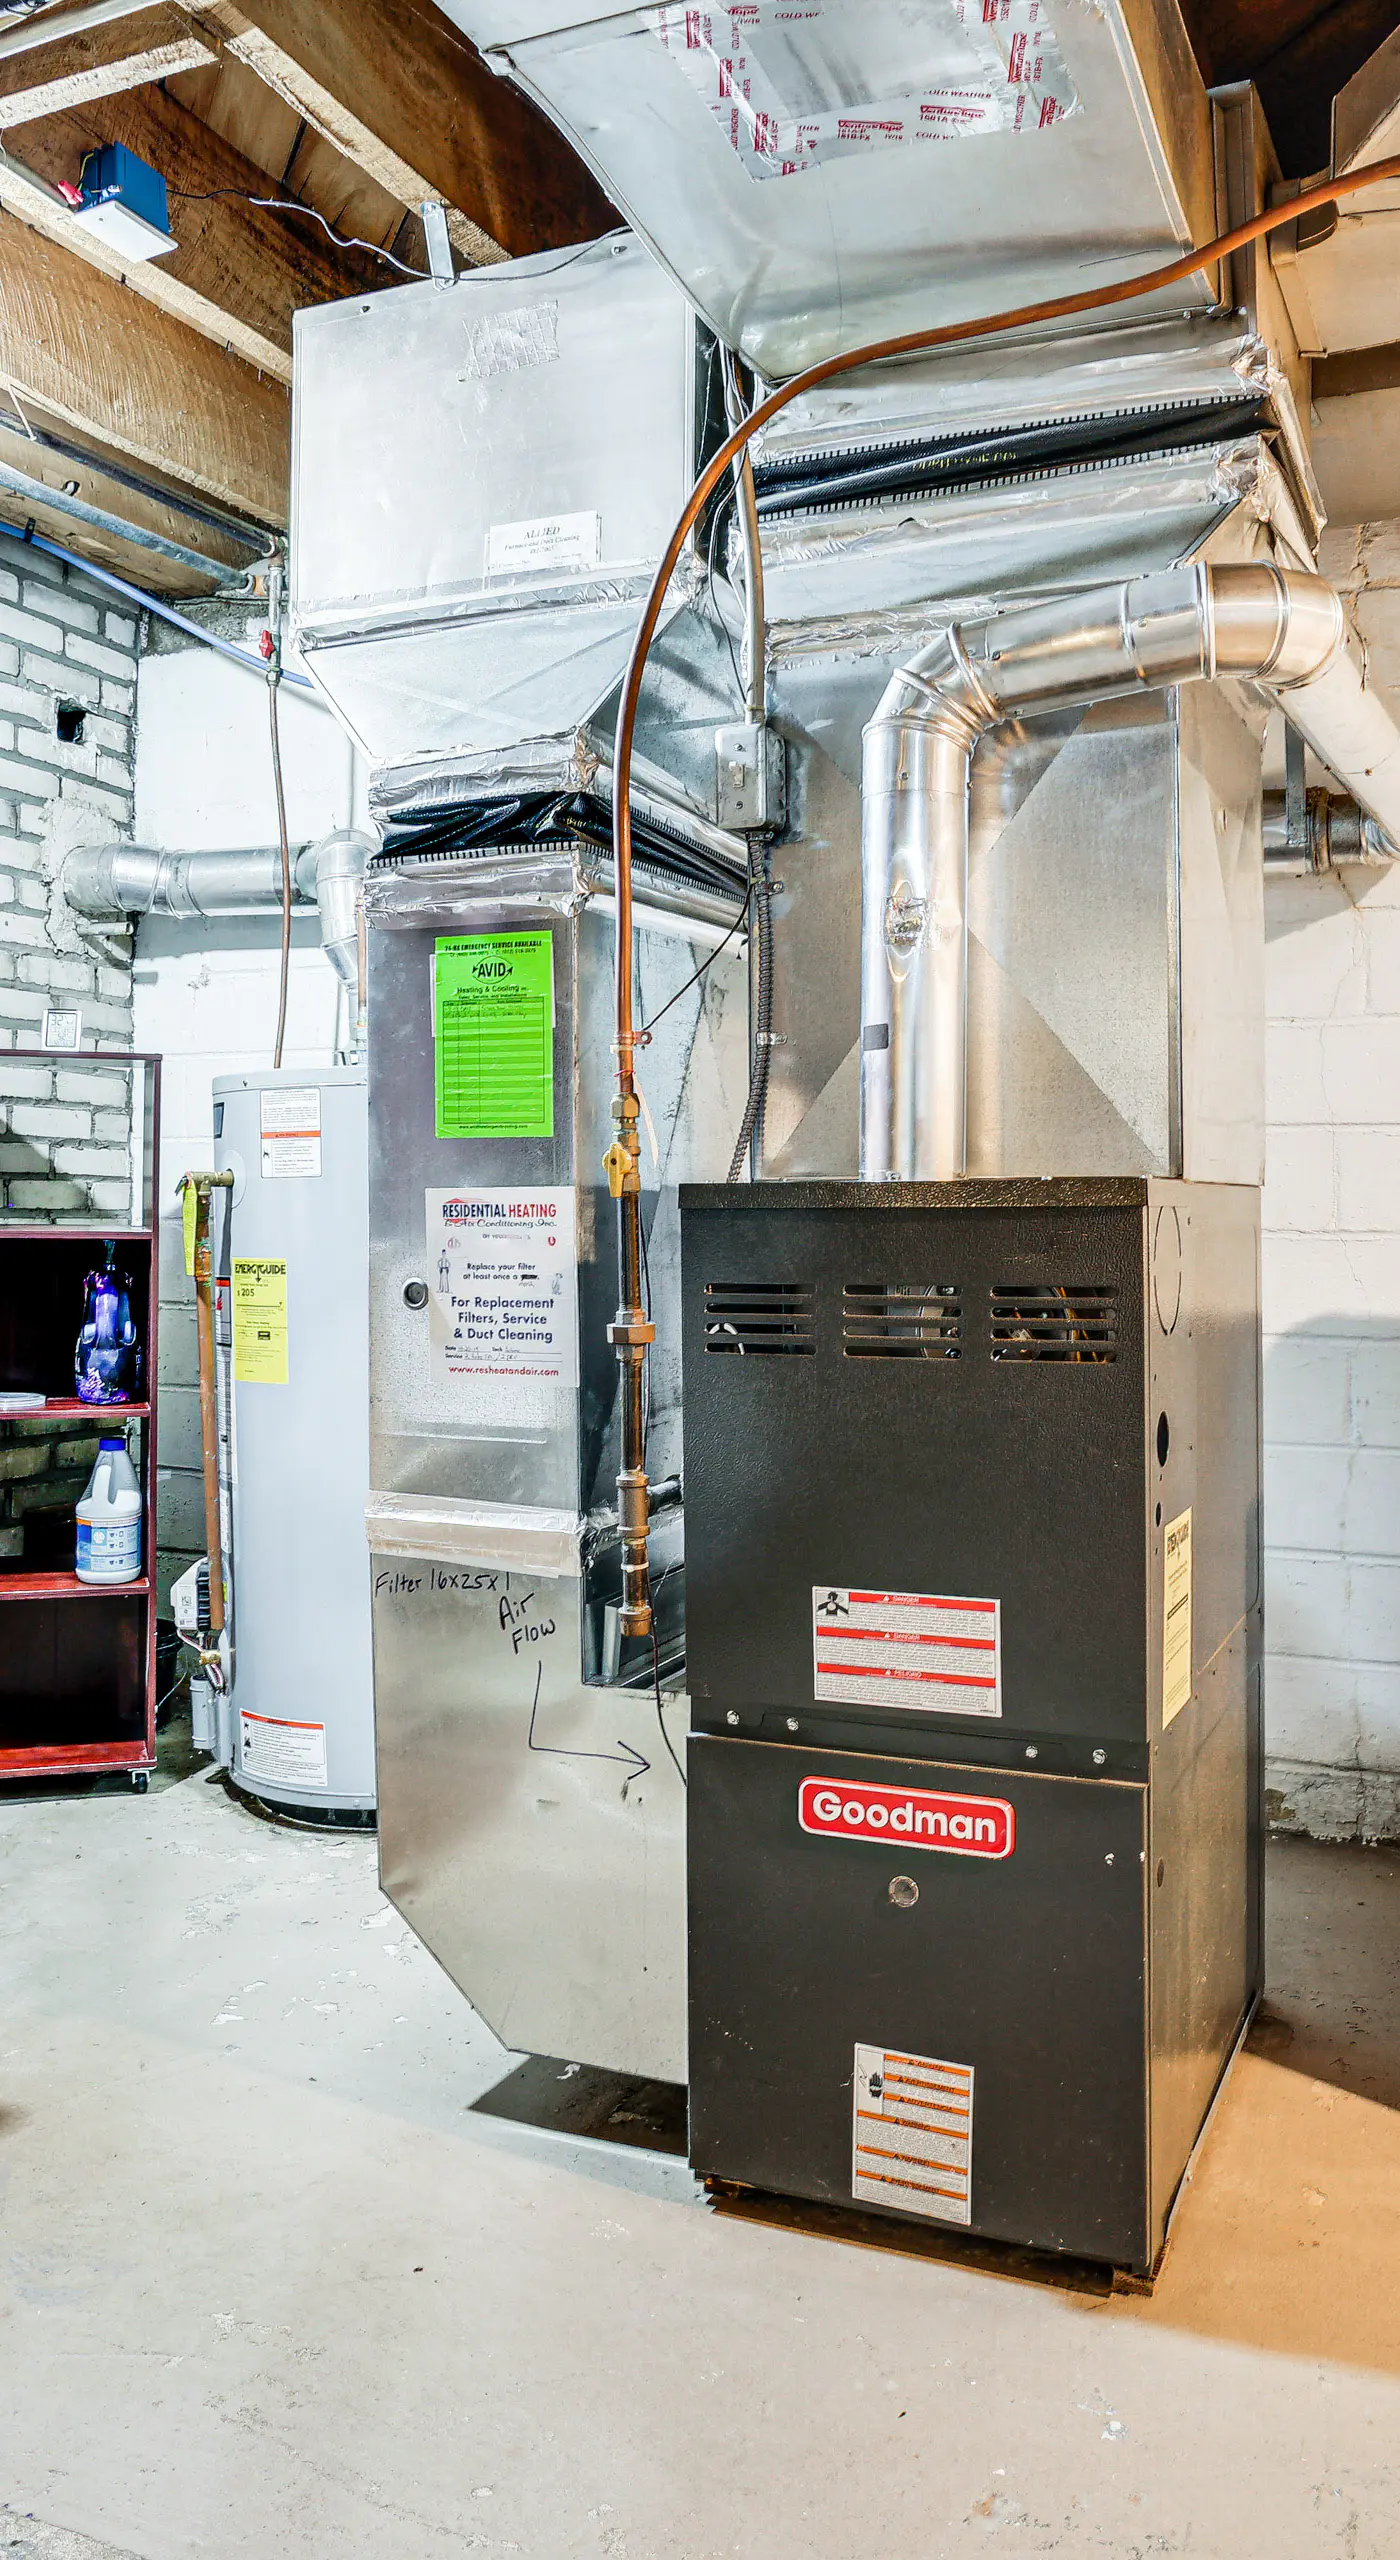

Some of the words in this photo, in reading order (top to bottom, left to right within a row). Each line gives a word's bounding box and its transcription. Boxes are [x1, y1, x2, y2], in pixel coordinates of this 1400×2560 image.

[477, 962, 507, 978] AVID
[491, 985, 520, 993] Cooling
[442, 1203, 506, 1218] RESIDENTIAL
[508, 1203, 557, 1218] HEATING
[477, 1219, 533, 1228] Conditioning
[467, 1263, 495, 1271] Replace
[498, 1264, 515, 1272] your
[518, 1262, 536, 1270] filter
[451, 1296, 470, 1307] For
[475, 1296, 555, 1311] Replacement
[458, 1311, 499, 1325] Filters,
[502, 1312, 548, 1325] Service
[453, 1327, 463, 1339] &
[467, 1328, 494, 1339] Duct
[498, 1328, 553, 1344] Cleaning
[448, 1366, 559, 1376] www.resheatandair.com
[375, 1571, 422, 1598] Filter
[498, 1592, 535, 1631] Air
[511, 1618, 556, 1654] Flow
[812, 1791, 997, 1843] Goodman
